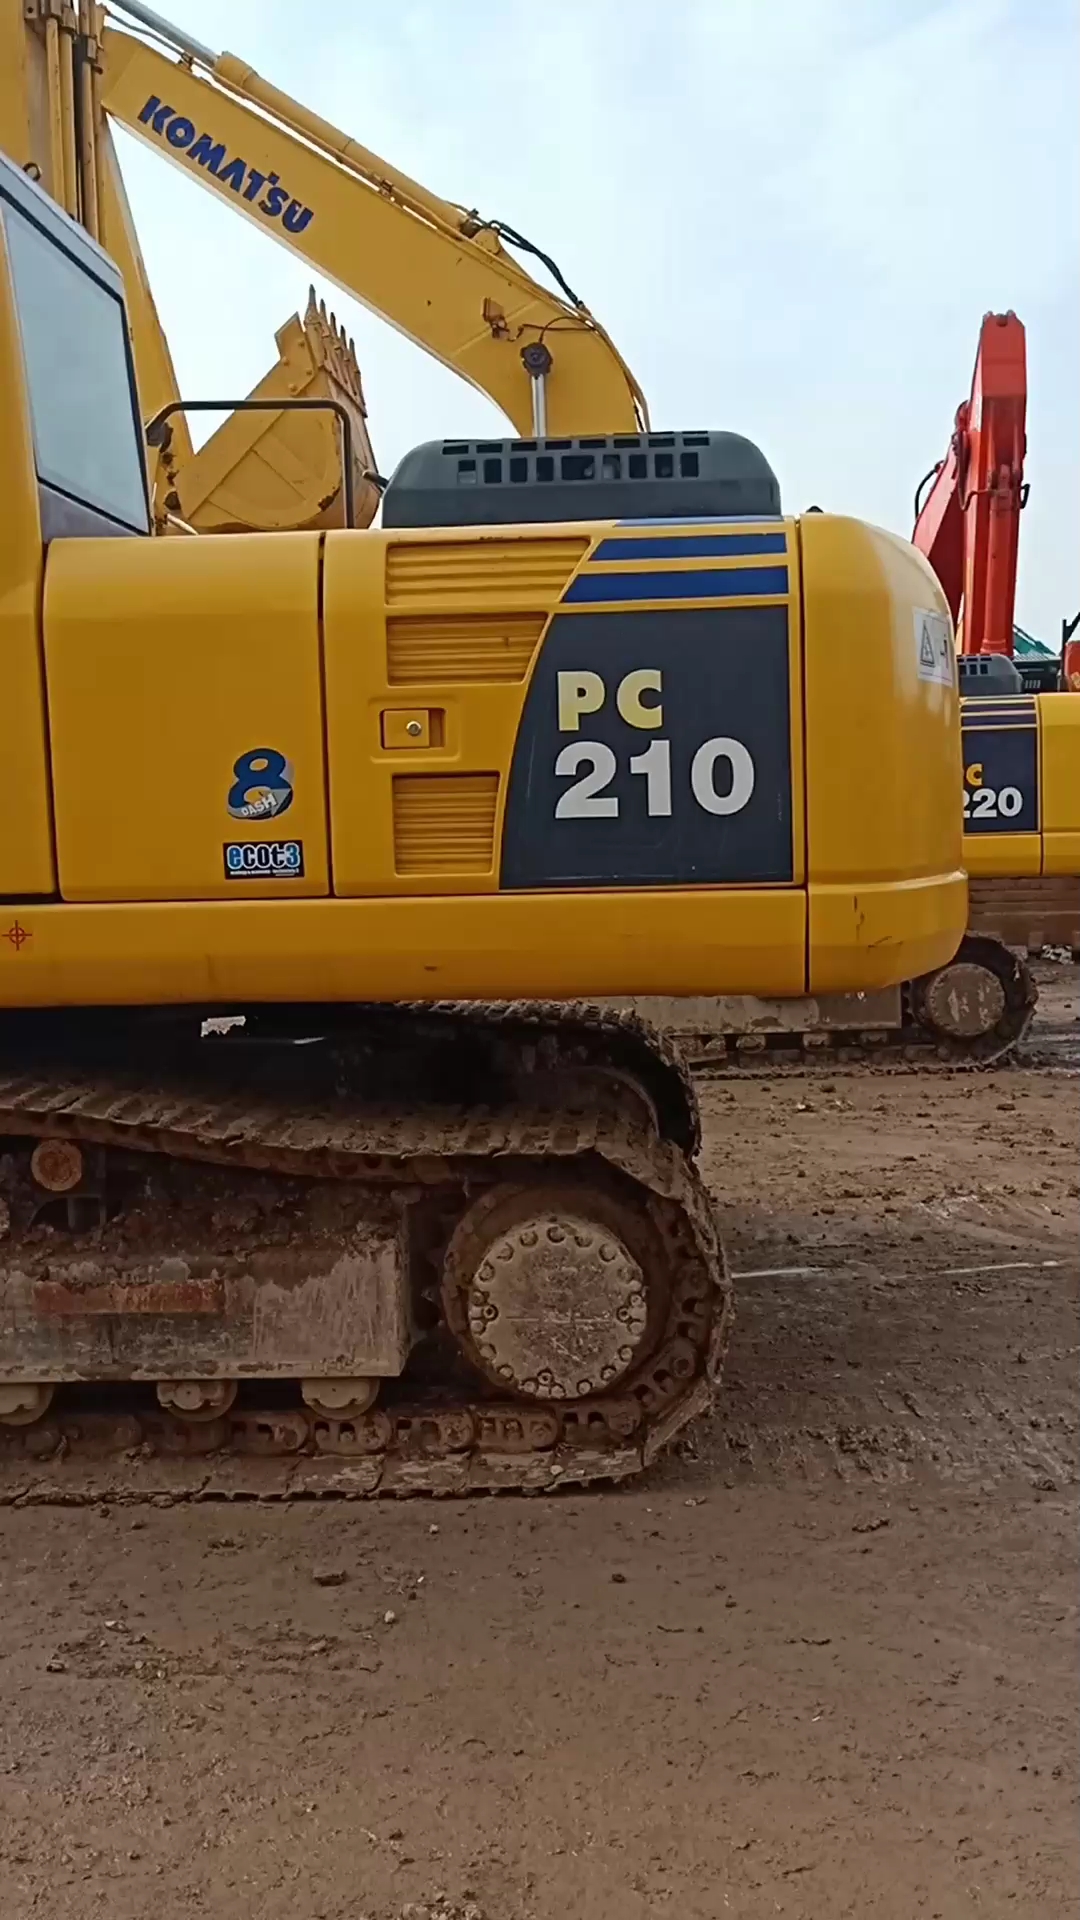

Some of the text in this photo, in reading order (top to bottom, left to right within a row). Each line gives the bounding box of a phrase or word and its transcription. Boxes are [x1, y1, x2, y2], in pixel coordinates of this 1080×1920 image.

[137, 94, 314, 233] KOMATSU
[557, 668, 663, 731] PC
[228, 748, 293, 820] 8
[241, 792, 278, 816] DASH
[555, 736, 755, 819] 210
[963, 763, 983, 787] C
[227, 842, 300, 870] ecot3
